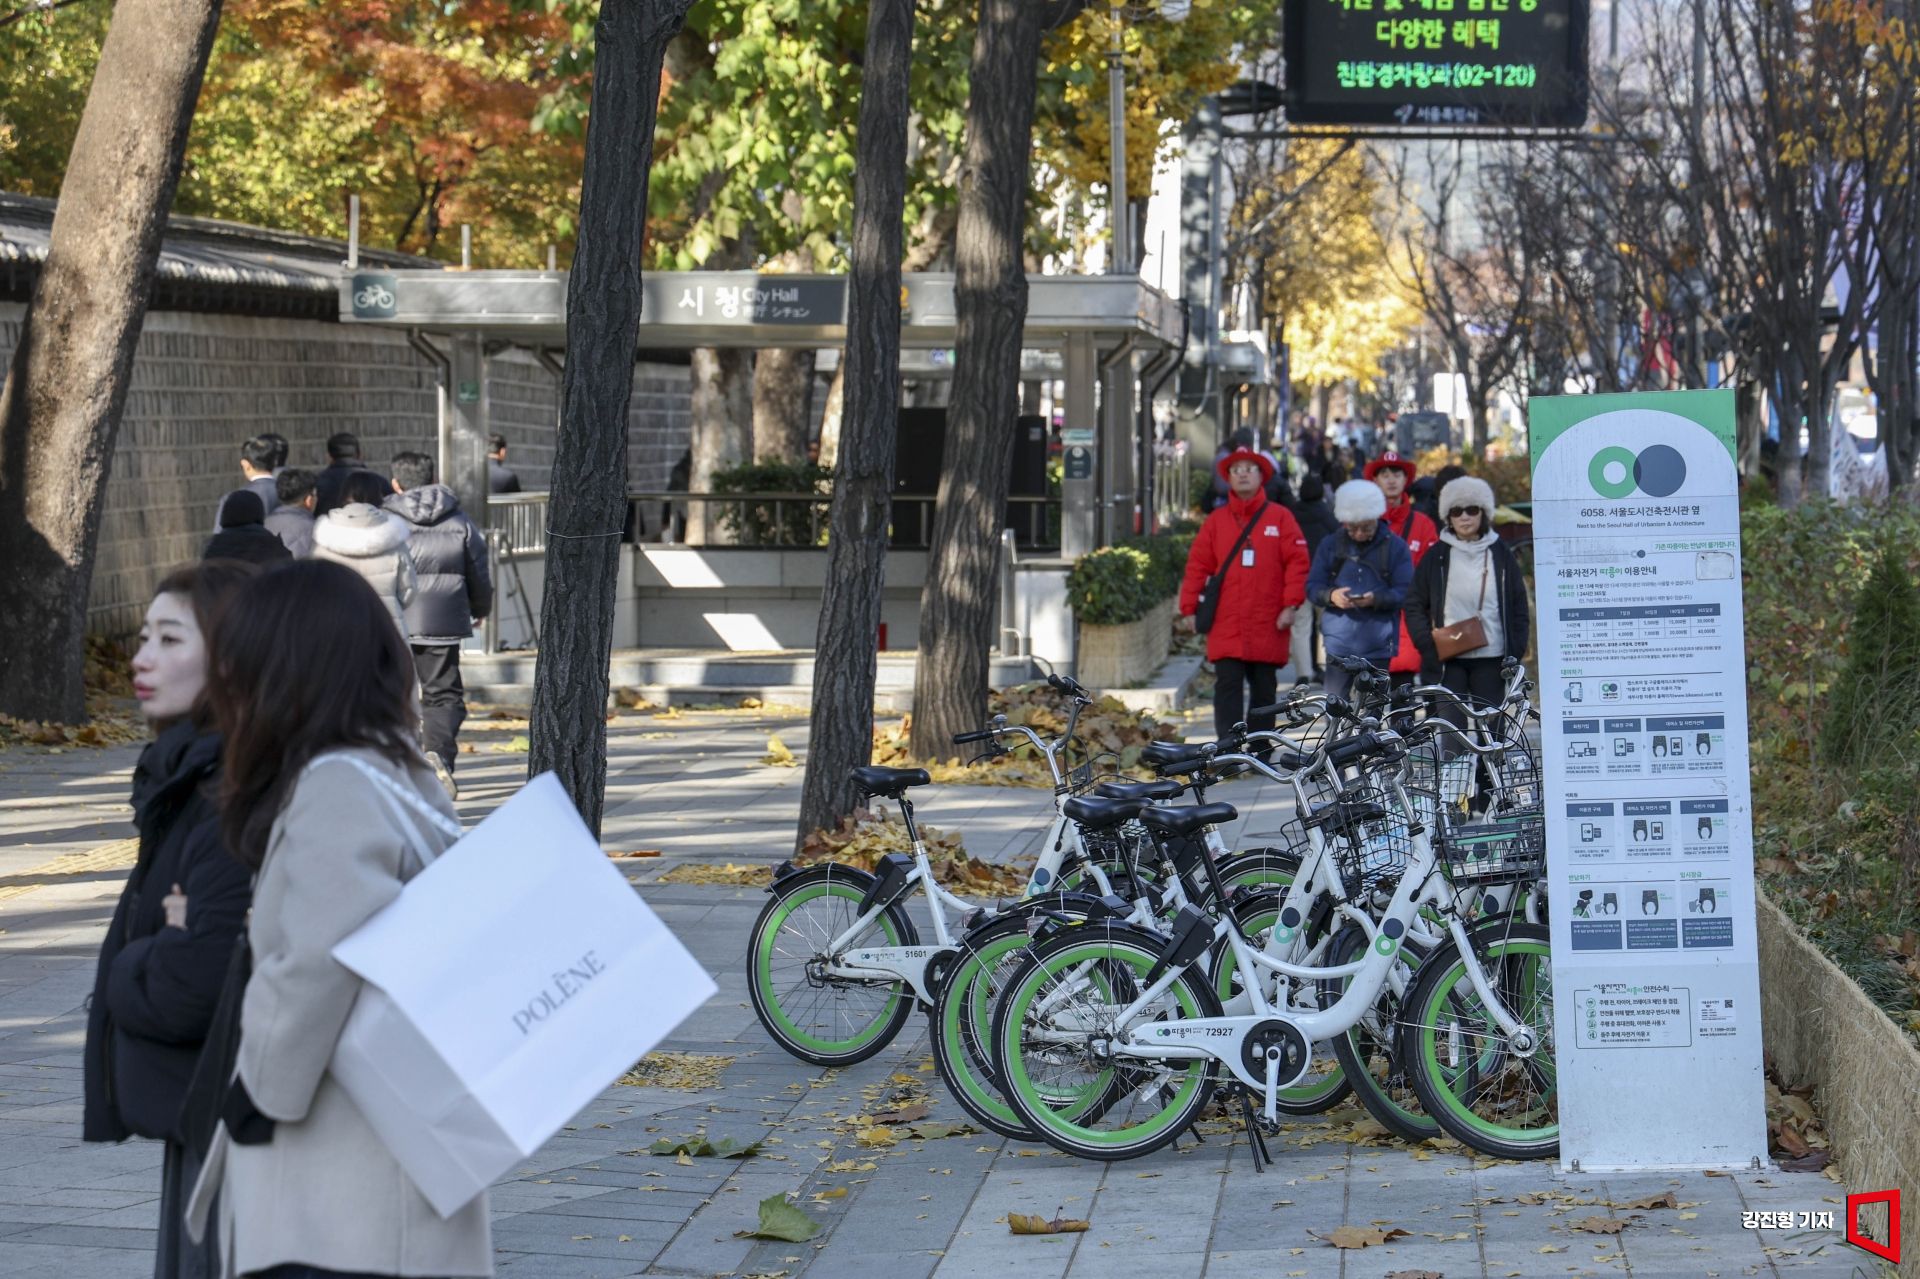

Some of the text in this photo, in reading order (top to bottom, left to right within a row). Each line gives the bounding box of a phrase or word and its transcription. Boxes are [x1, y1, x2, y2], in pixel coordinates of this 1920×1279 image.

[1376, 18, 1500, 49] 다양한 혜택
[1337, 61, 1537, 88] 친환경차량과(02-120)
[1416, 106, 1479, 122] 서울특별시
[742, 287, 799, 304] City Hall
[771, 306, 810, 318] シチョン
[1581, 505, 1700, 518] 6058. 서울도시건축전시관 옆
[1557, 566, 1657, 579] 서울자전거 따릉이 이용안내
[905, 950, 927, 958] 51601
[1643, 984, 1670, 993] 안전수칙
[1171, 1028, 1192, 1038] 따릉이
[1205, 1028, 1234, 1036] 72927
